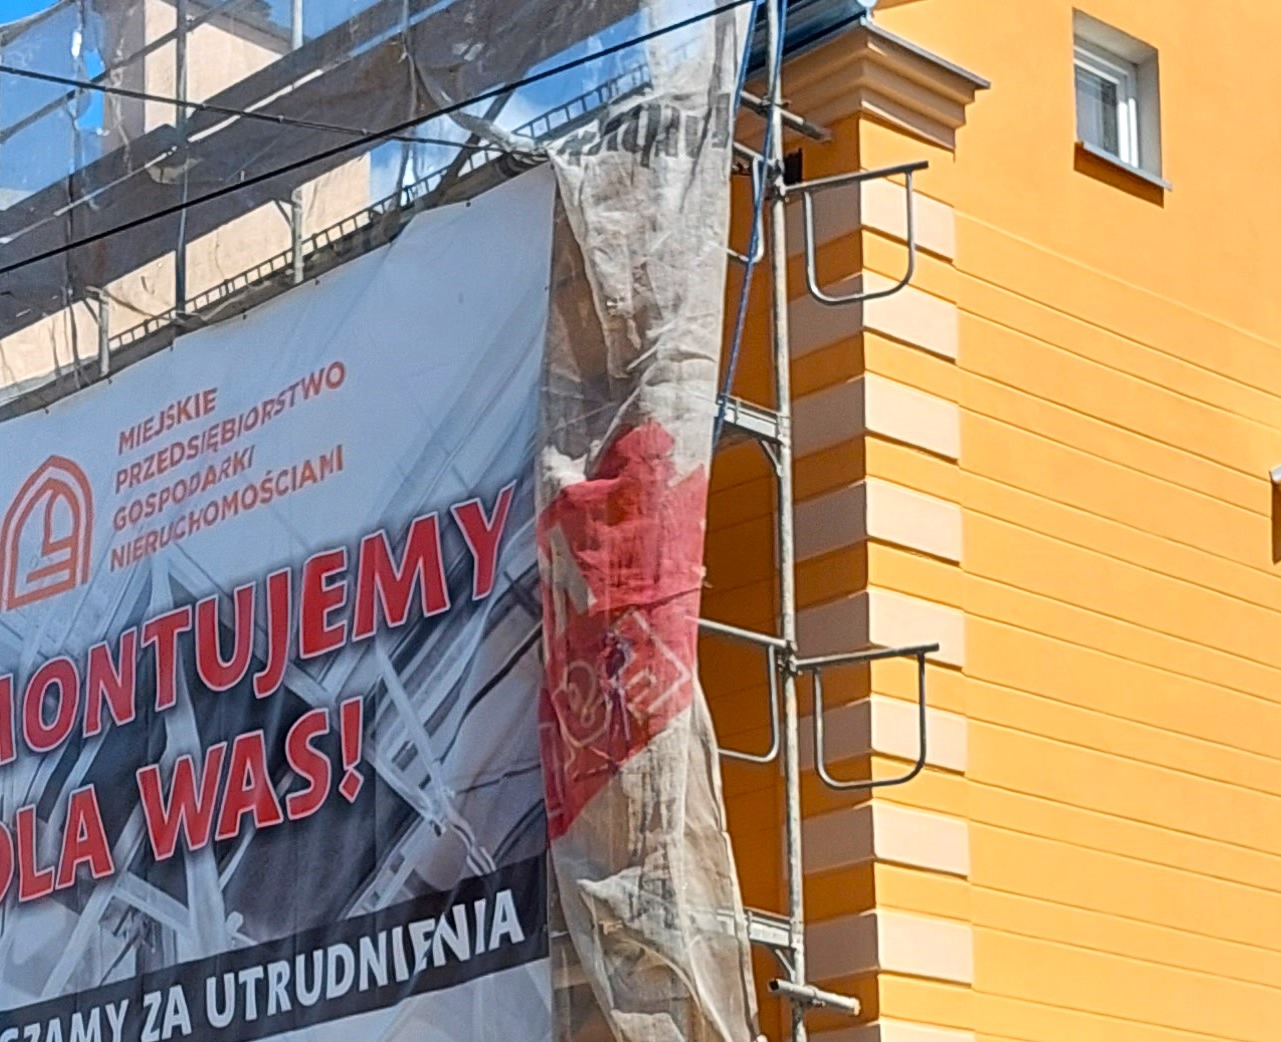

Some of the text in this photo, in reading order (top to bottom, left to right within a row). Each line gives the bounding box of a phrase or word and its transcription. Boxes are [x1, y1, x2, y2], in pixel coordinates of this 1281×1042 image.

[116, 361, 346, 494] PRZEDSIĘBIORSTWO
[118, 387, 217, 456] MIEJSKIE
[110, 444, 344, 572] NIERUCHOMOŚCIAMI
[113, 445, 256, 532] GOSPODARKI
[137, 697, 364, 861] WAS!
[141, 987, 192, 1042] ZA
[207, 889, 524, 1028] UTRUDNIENIA
